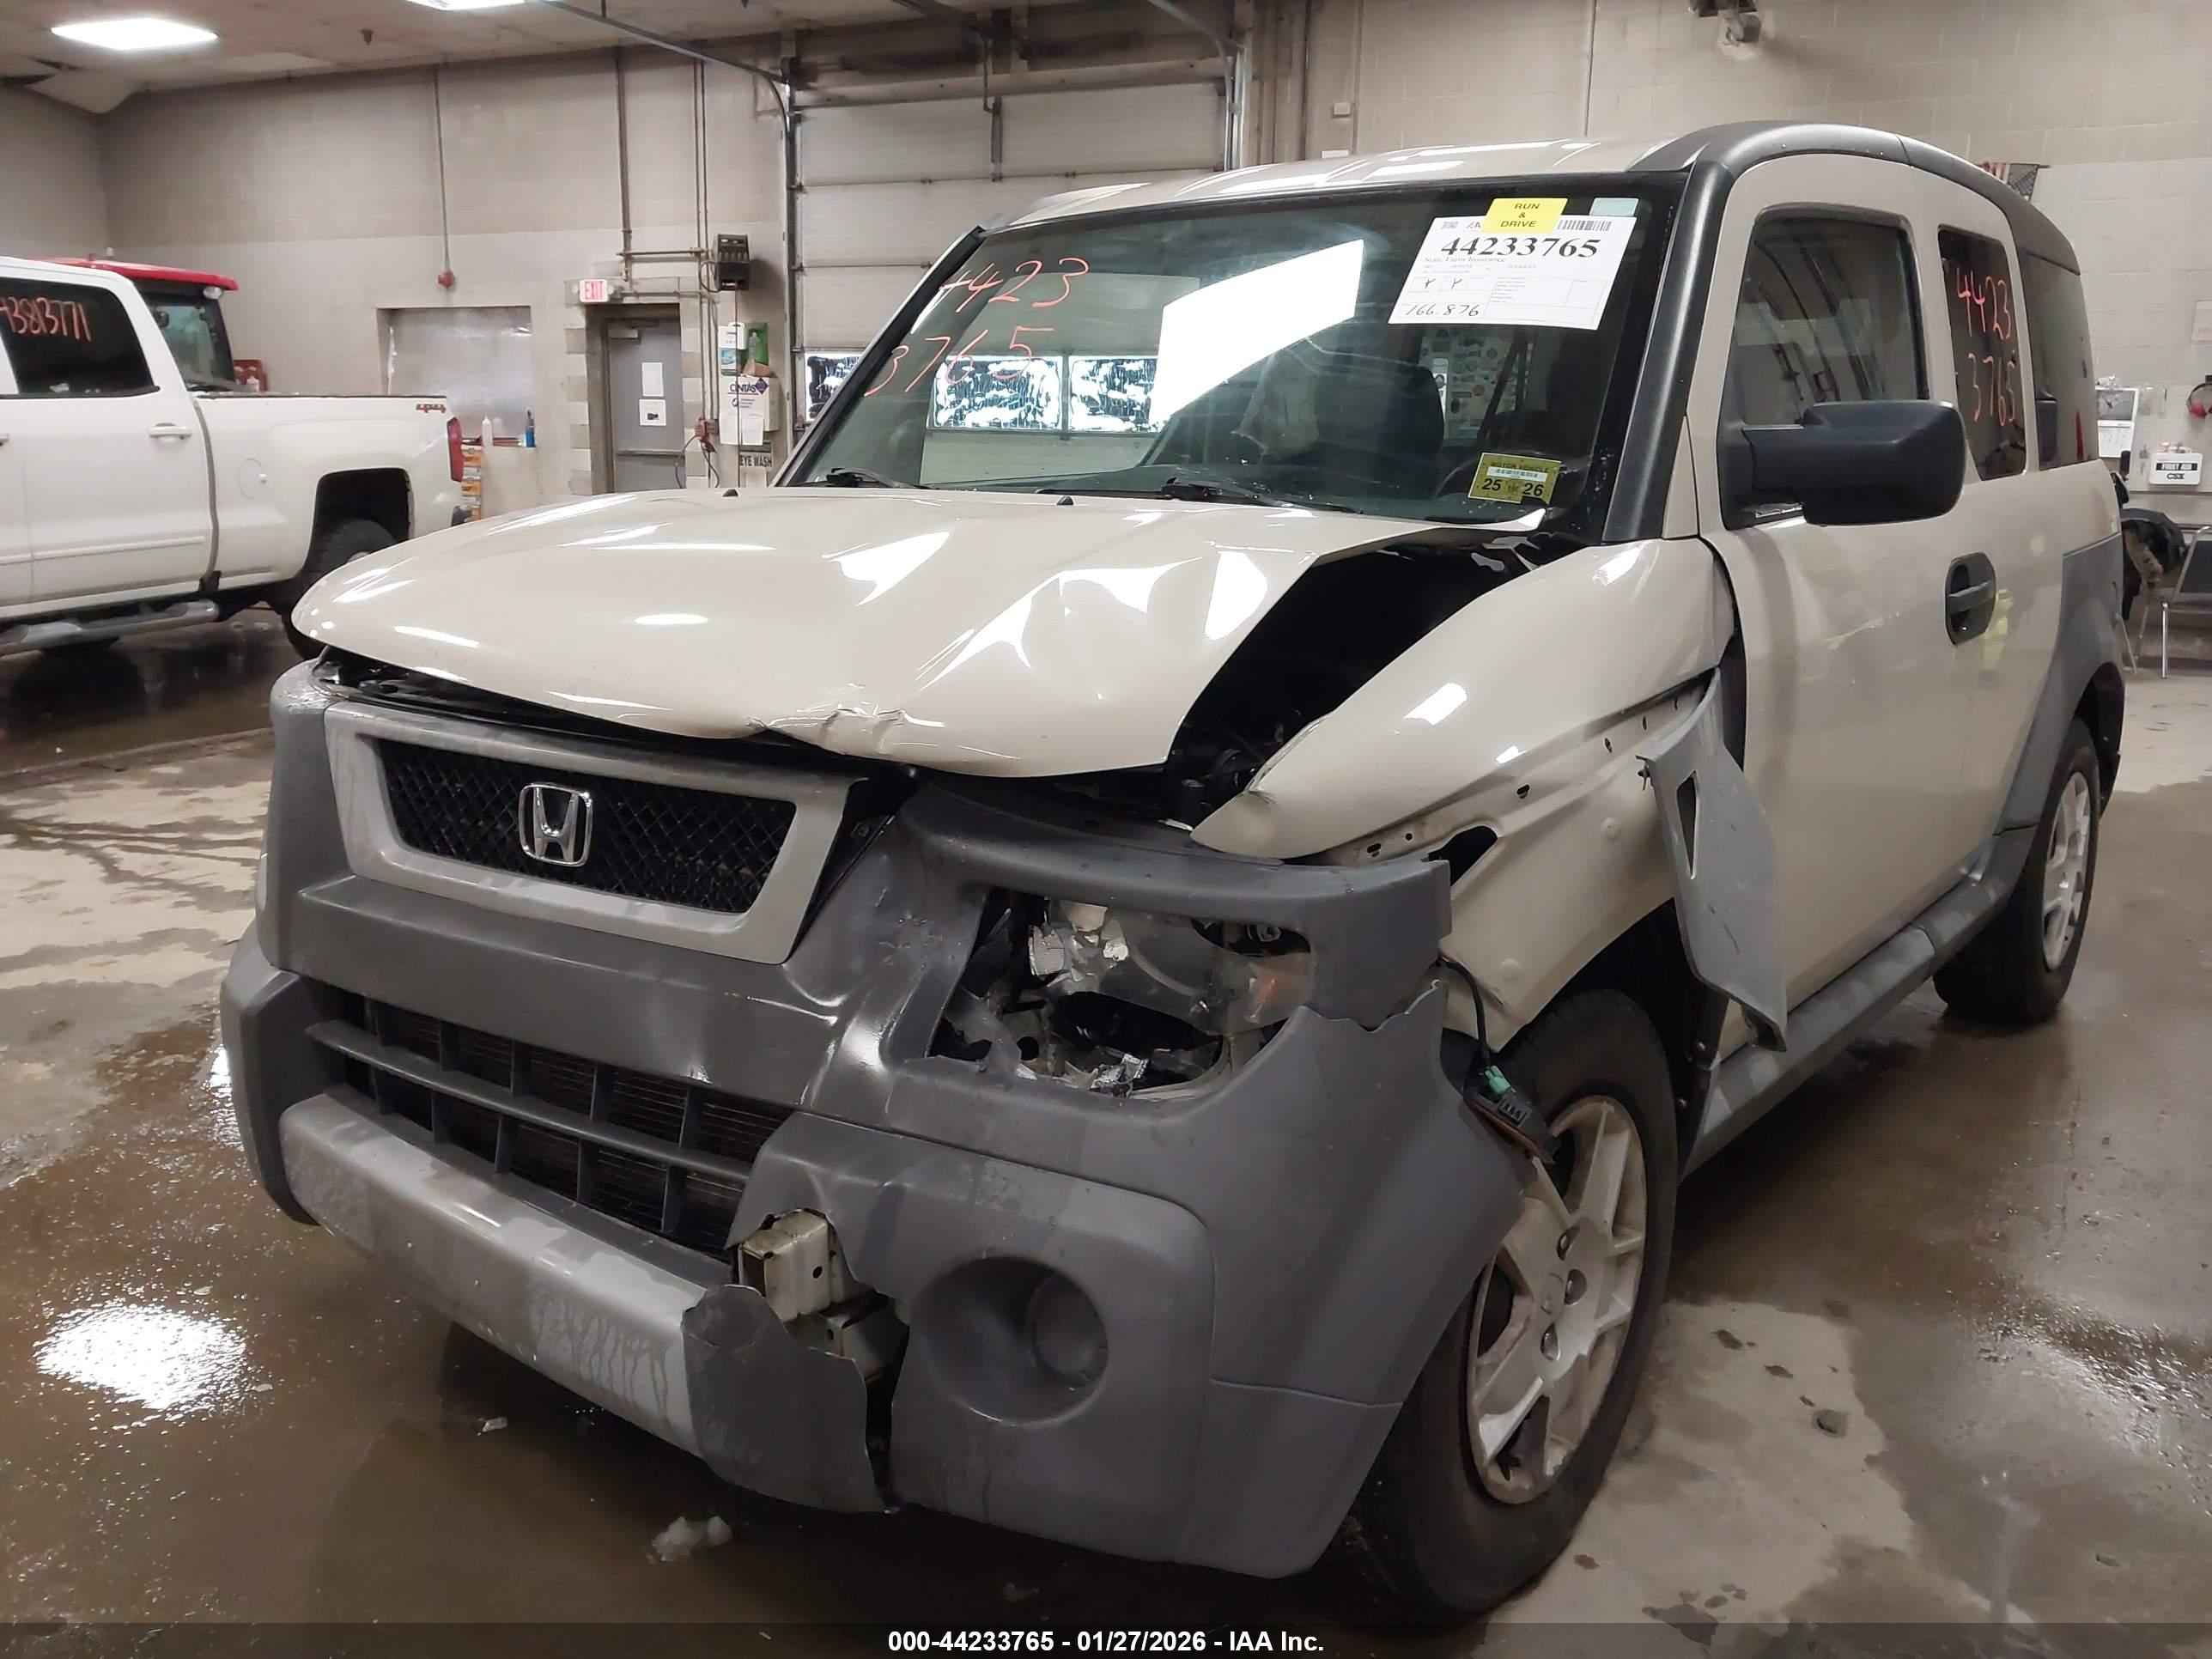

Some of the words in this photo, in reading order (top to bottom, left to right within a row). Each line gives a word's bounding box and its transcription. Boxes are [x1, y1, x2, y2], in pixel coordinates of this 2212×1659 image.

[1441, 237, 1601, 258] 44233765
[584, 280, 605, 300] EXIT
[1956, 267, 2011, 341] 4423
[864, 325, 1054, 398] 3765
[1967, 352, 2015, 427] 3765
[1481, 478, 1503, 491] 25
[1522, 483, 1544, 496] 26
